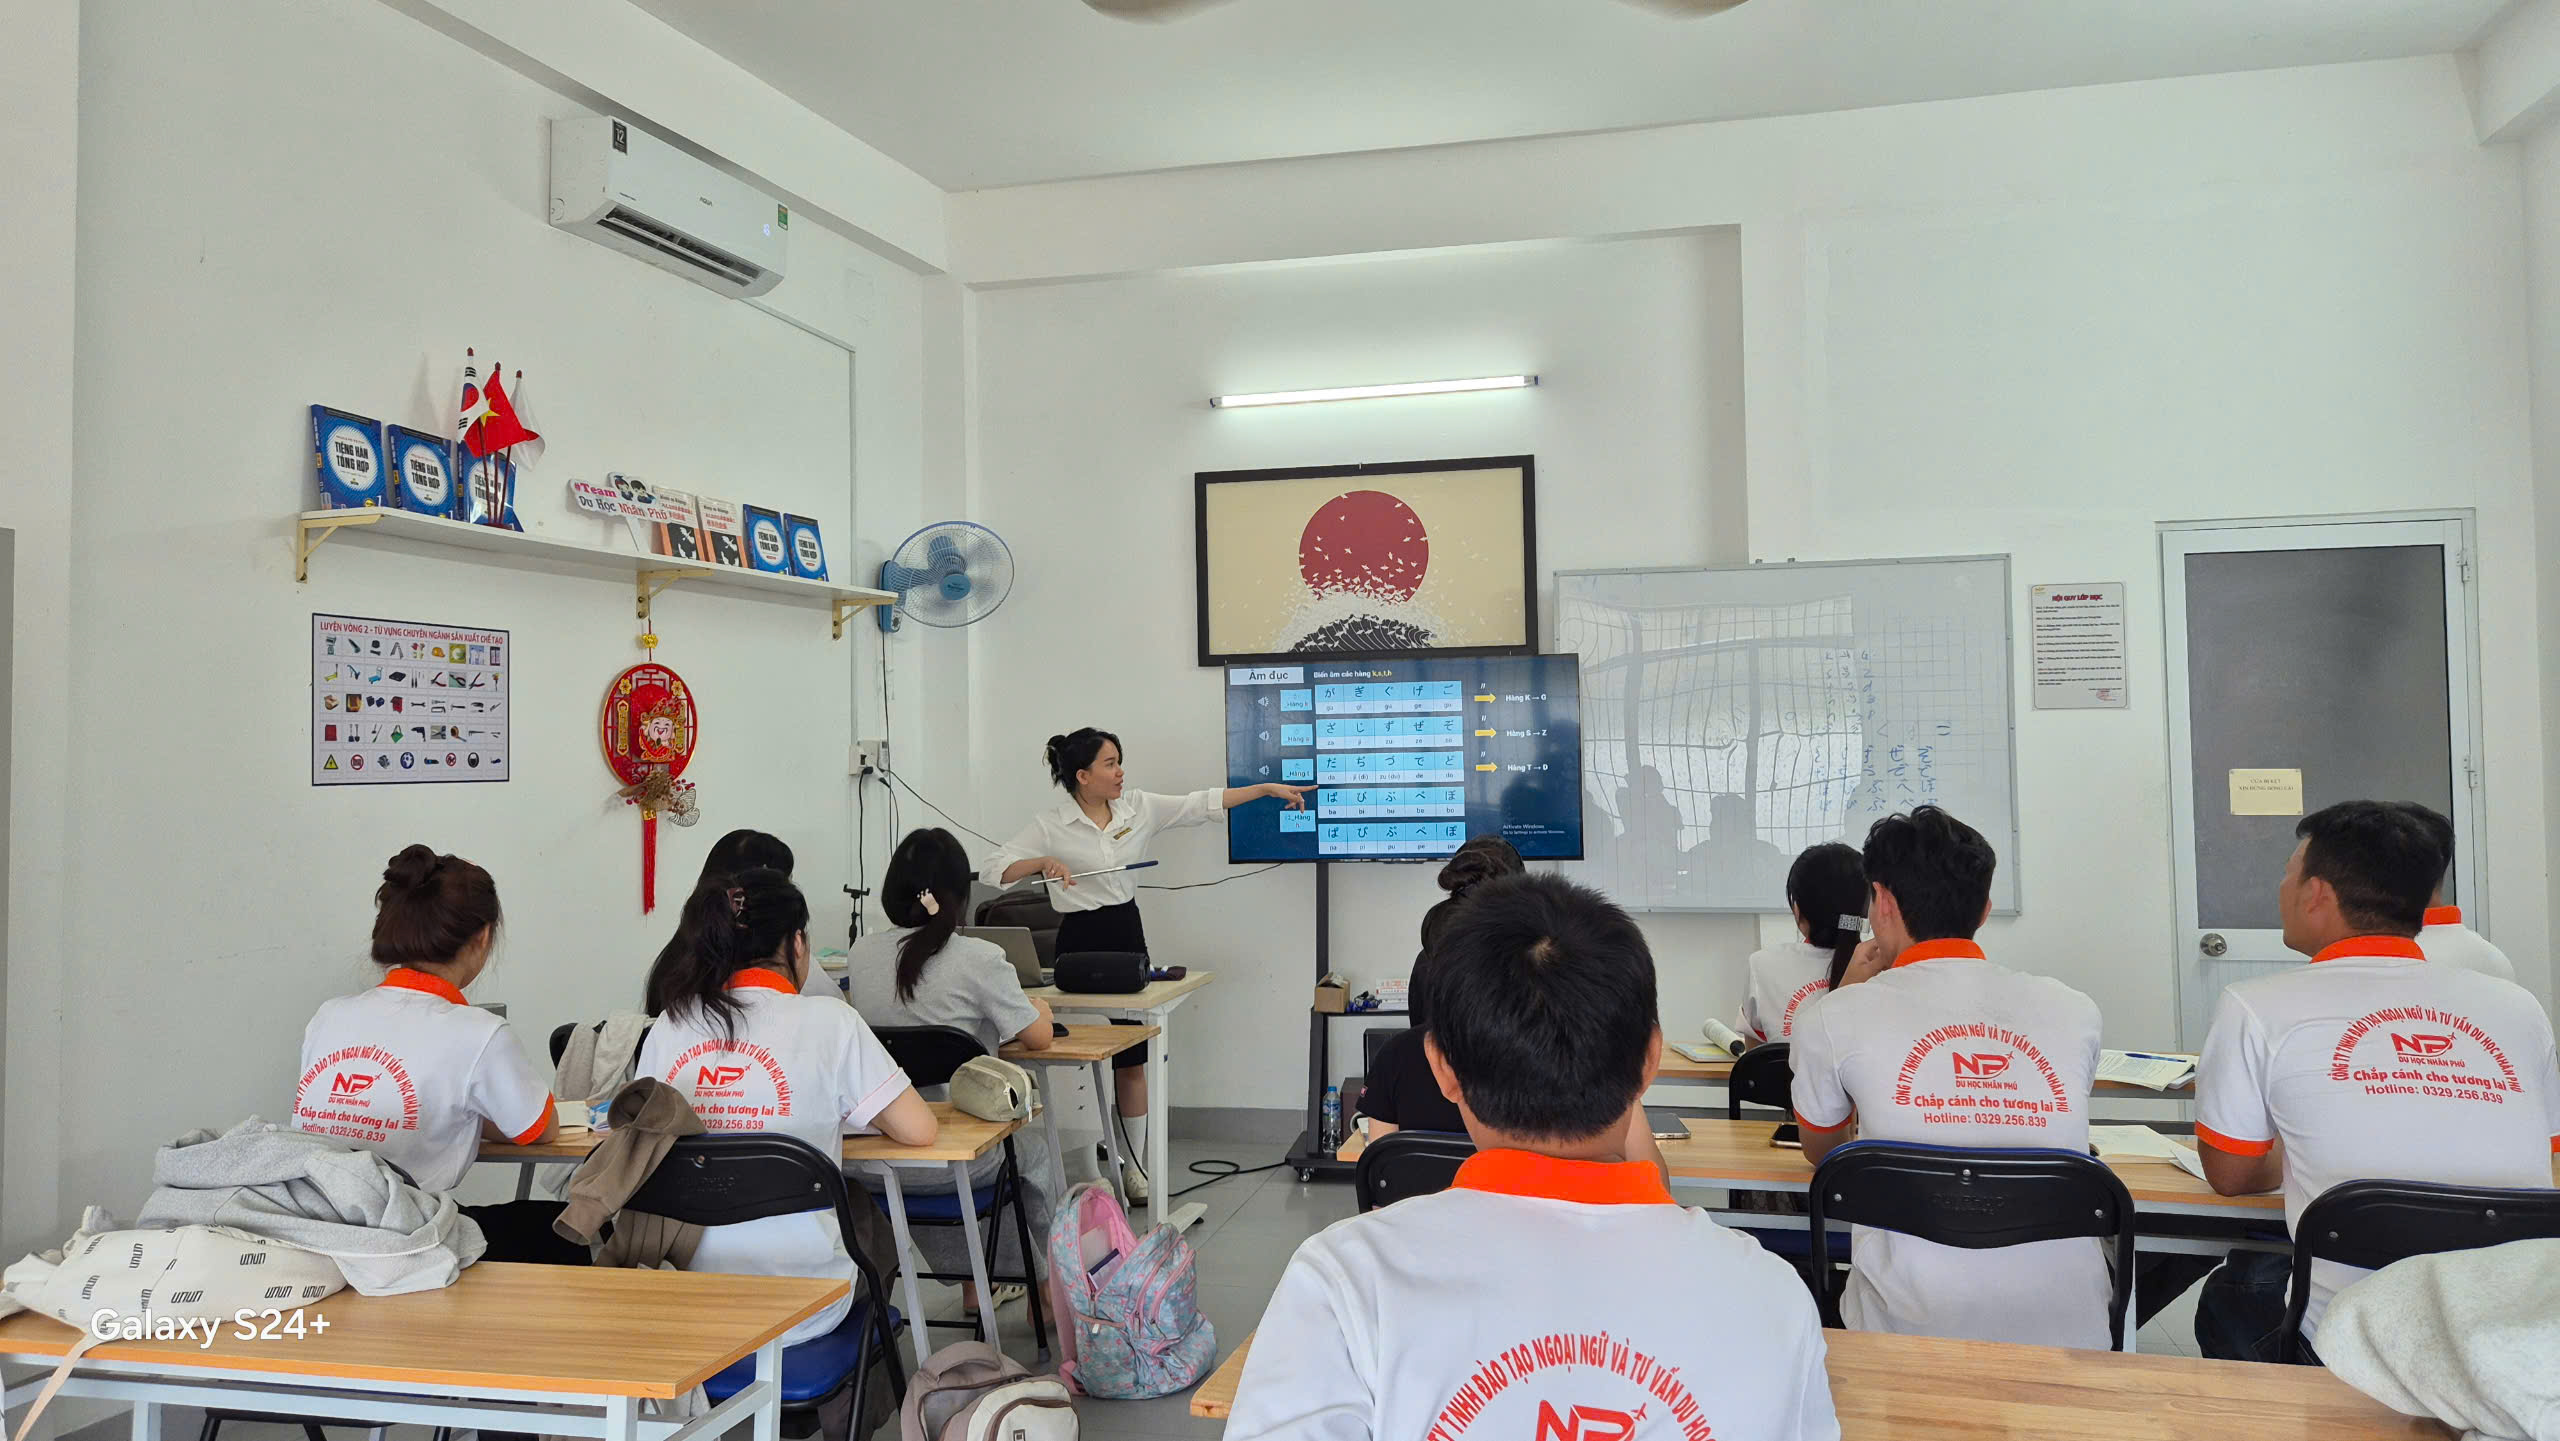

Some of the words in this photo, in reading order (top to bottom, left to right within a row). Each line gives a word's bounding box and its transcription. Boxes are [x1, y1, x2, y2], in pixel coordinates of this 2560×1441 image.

[574, 482, 616, 498] #Team
[596, 498, 616, 512] Học
[618, 503, 645, 517] Nhân
[648, 507, 667, 519] Phú
[320, 621, 341, 631] LUYỆN
[343, 623, 363, 633] VÒNG
[403, 628, 427, 638] CHUYÊN
[429, 630, 450, 640] NGÀNH
[1249, 668, 1266, 681] Âm
[1270, 671, 1288, 682] đục
[1355, 671, 1371, 679] hàng
[1944, 1024, 1968, 1040] NGOẠI
[1970, 1023, 1985, 1037] NGỮ
[1988, 1024, 1998, 1040] VÀ
[2002, 1030, 2013, 1043] TƯ
[2333, 1047, 2350, 1062] TY
[2377, 1008, 2404, 1023] NGOẠI
[2404, 1005, 2423, 1020] NGỮ
[2425, 1007, 2437, 1022] VÀ
[2440, 1011, 2452, 1025] TƯ
[2453, 1017, 2471, 1034] VẤN
[2470, 1028, 2484, 1040] DU
[2481, 1037, 2500, 1055] HỌC
[1926, 1029, 1946, 1046] TẠO
[2029, 1046, 2040, 1060] DU
[1901, 1051, 1922, 1074] TNHH
[2411, 1057, 2425, 1066] HỌC
[2427, 1057, 2448, 1067] NHÂN
[2450, 1060, 2465, 1068] PHÚ
[1898, 1073, 1913, 1083] TY
[1956, 1080, 1965, 1088] DU
[1968, 1080, 1981, 1090] HỌC
[1983, 1080, 2002, 1090] NHÂN
[2004, 1080, 2017, 1090] PHÚ
[2354, 1067, 2388, 1082] Chắp
[2392, 1069, 2423, 1081] cánh
[2426, 1071, 2449, 1083] cho
[2452, 1074, 2491, 1089] tương
[2493, 1078, 2507, 1090] lai
[2365, 1084, 2420, 1095] Hotline:
[2423, 1085, 2503, 1103] 0329.256.839
[1914, 1093, 1944, 1109] Chắp
[1948, 1095, 1976, 1107] cánh
[1980, 1096, 1999, 1108] cho
[2004, 1098, 2037, 1113] tương
[2041, 1099, 2053, 1112] lai
[300, 1106, 316, 1120] Chắp
[318, 1109, 336, 1120] cánh
[338, 1111, 350, 1121] cho
[352, 1113, 382, 1129] tương
[708, 1104, 724, 1114] cho
[728, 1104, 758, 1117] tương
[761, 1105, 774, 1116] lai
[1924, 1113, 1971, 1124] Hotline:
[1975, 1113, 2046, 1127] 0329.256.839
[302, 1123, 328, 1134] Hotline:
[240, 1252, 266, 1265] unun
[171, 1290, 203, 1303] unun
[265, 1286, 292, 1298] unun
[303, 1285, 325, 1298] unun
[1439, 1383, 1485, 1433] TNHH
[1471, 1360, 1508, 1400] ĐÀO
[1500, 1344, 1534, 1384] TẠO
[1532, 1333, 1576, 1373] NGOẠI
[1580, 1330, 1609, 1368] NGỮ
[1611, 1338, 1629, 1376] VÀ
[1630, 1351, 1655, 1384] TƯ
[1648, 1367, 1684, 1407] VẤN
[1672, 1393, 1699, 1423] DU
